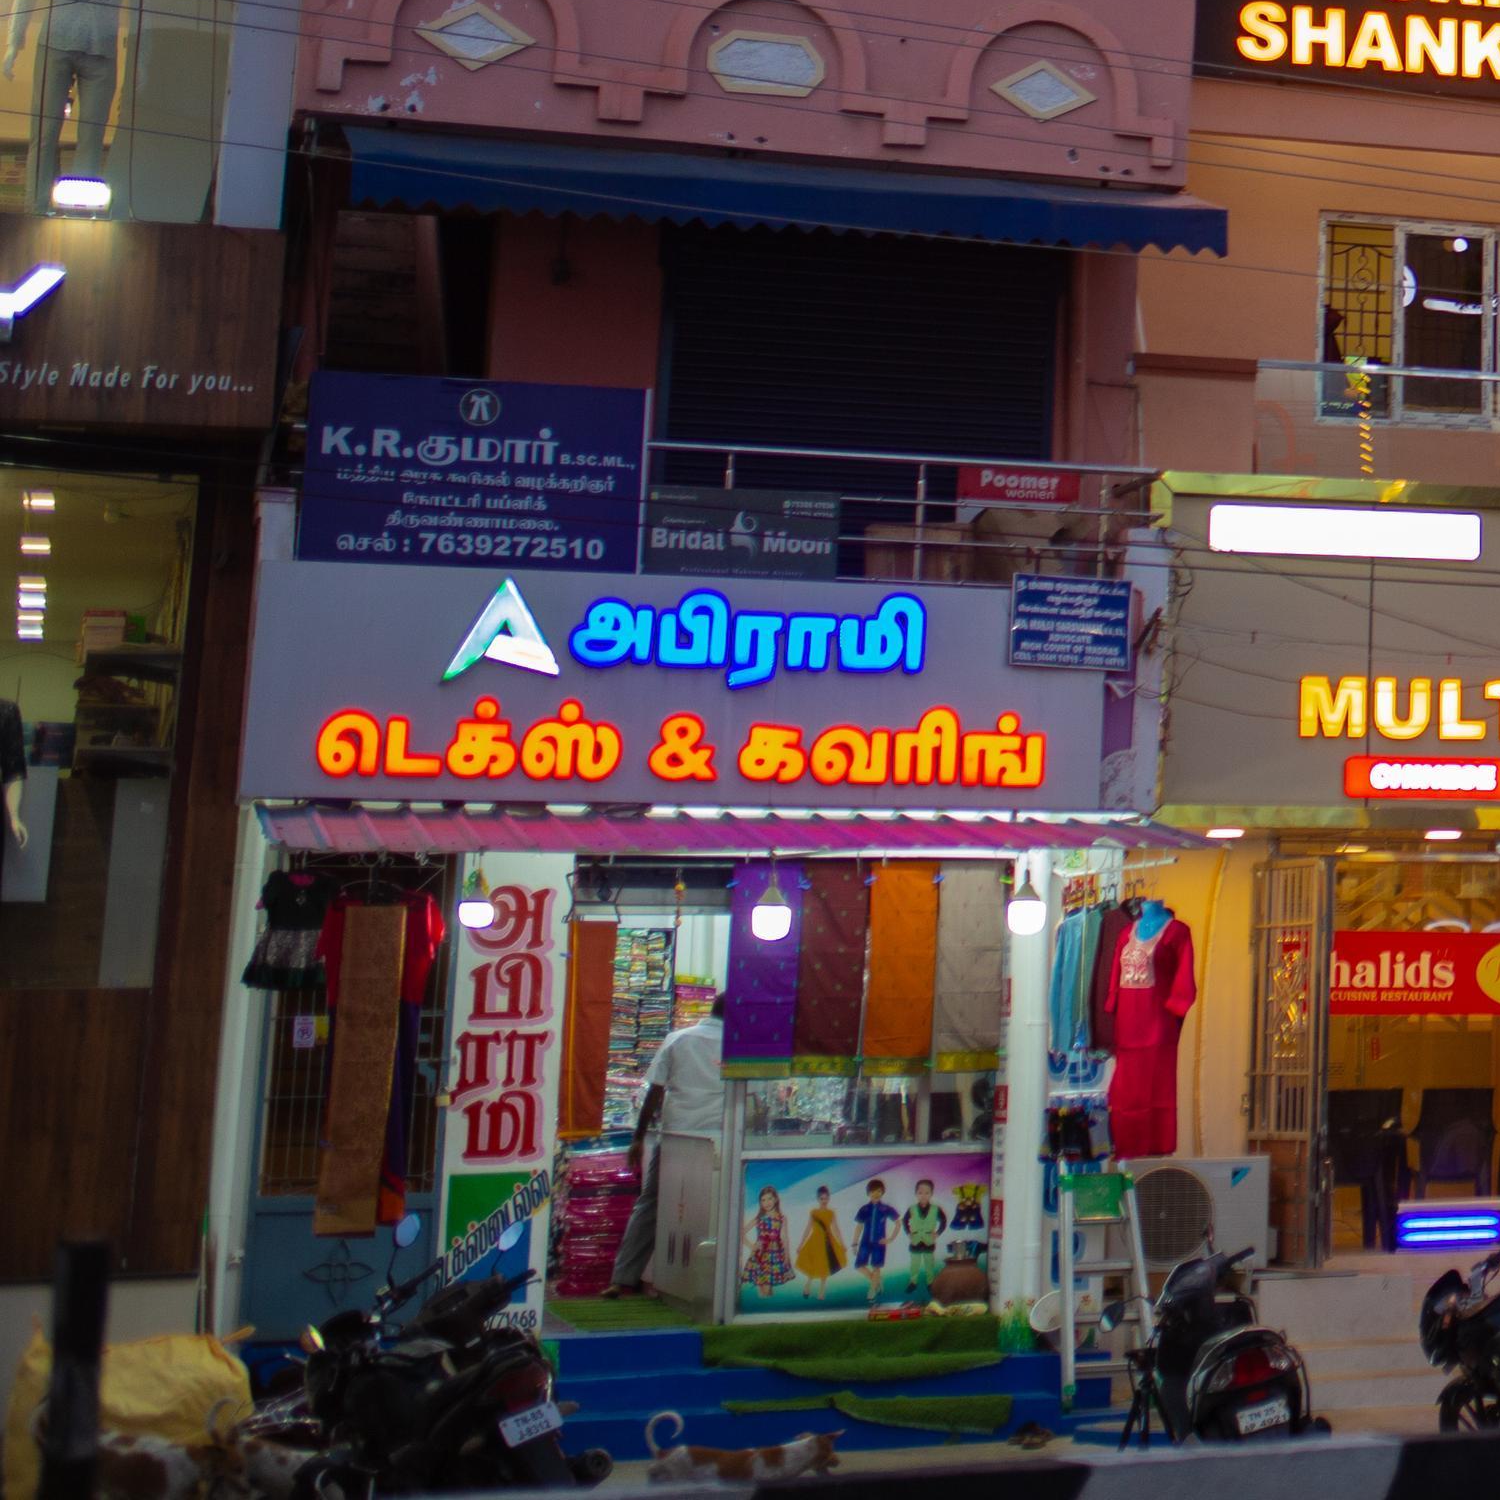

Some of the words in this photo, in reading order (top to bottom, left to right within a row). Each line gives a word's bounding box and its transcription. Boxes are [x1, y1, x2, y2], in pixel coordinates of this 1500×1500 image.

[0, 361, 58, 390] Style
[70, 363, 132, 388] Made
[141, 365, 180, 389] For
[321, 426, 560, 467] K.R.குமார்
[980, 468, 1060, 491] Poomer
[1005, 486, 1057, 501] women
[417, 531, 606, 561] 7639272510
[651, 526, 725, 551] Bridal
[763, 530, 833, 555] Moon
[568, 587, 927, 690] அபிராமி
[316, 695, 623, 782] டெக்ஸ்
[648, 710, 718, 783] &
[737, 705, 1048, 789] கவரிங்
[1330, 949, 1456, 989] halids
[1330, 990, 1378, 1003] CUISINE
[1380, 990, 1454, 1003] RESTAURANT
[449, 884, 551, 1160] அபிராமி
